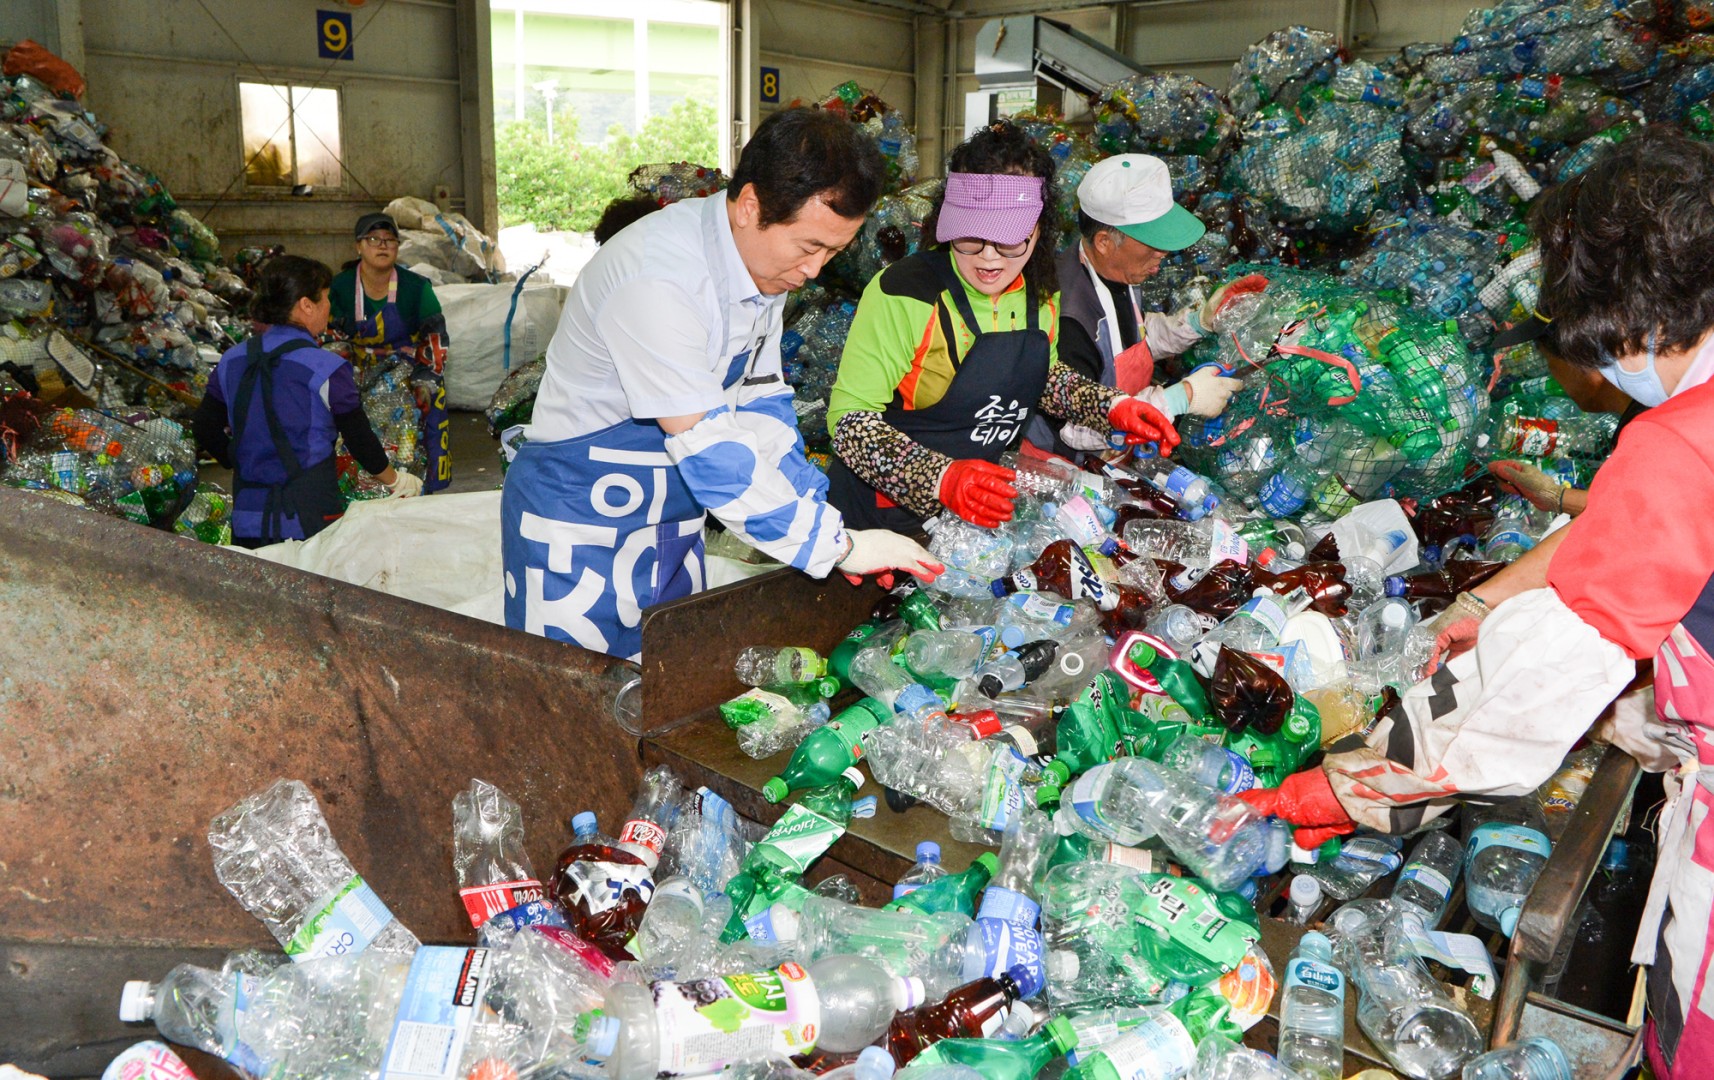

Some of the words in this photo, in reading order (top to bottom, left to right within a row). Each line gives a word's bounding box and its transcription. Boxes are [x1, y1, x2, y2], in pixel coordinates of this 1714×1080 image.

[323, 18, 347, 52] 9
[762, 73, 777, 98] 8
[970, 423, 1021, 447] 데이
[1010, 920, 1027, 974] SWEA
